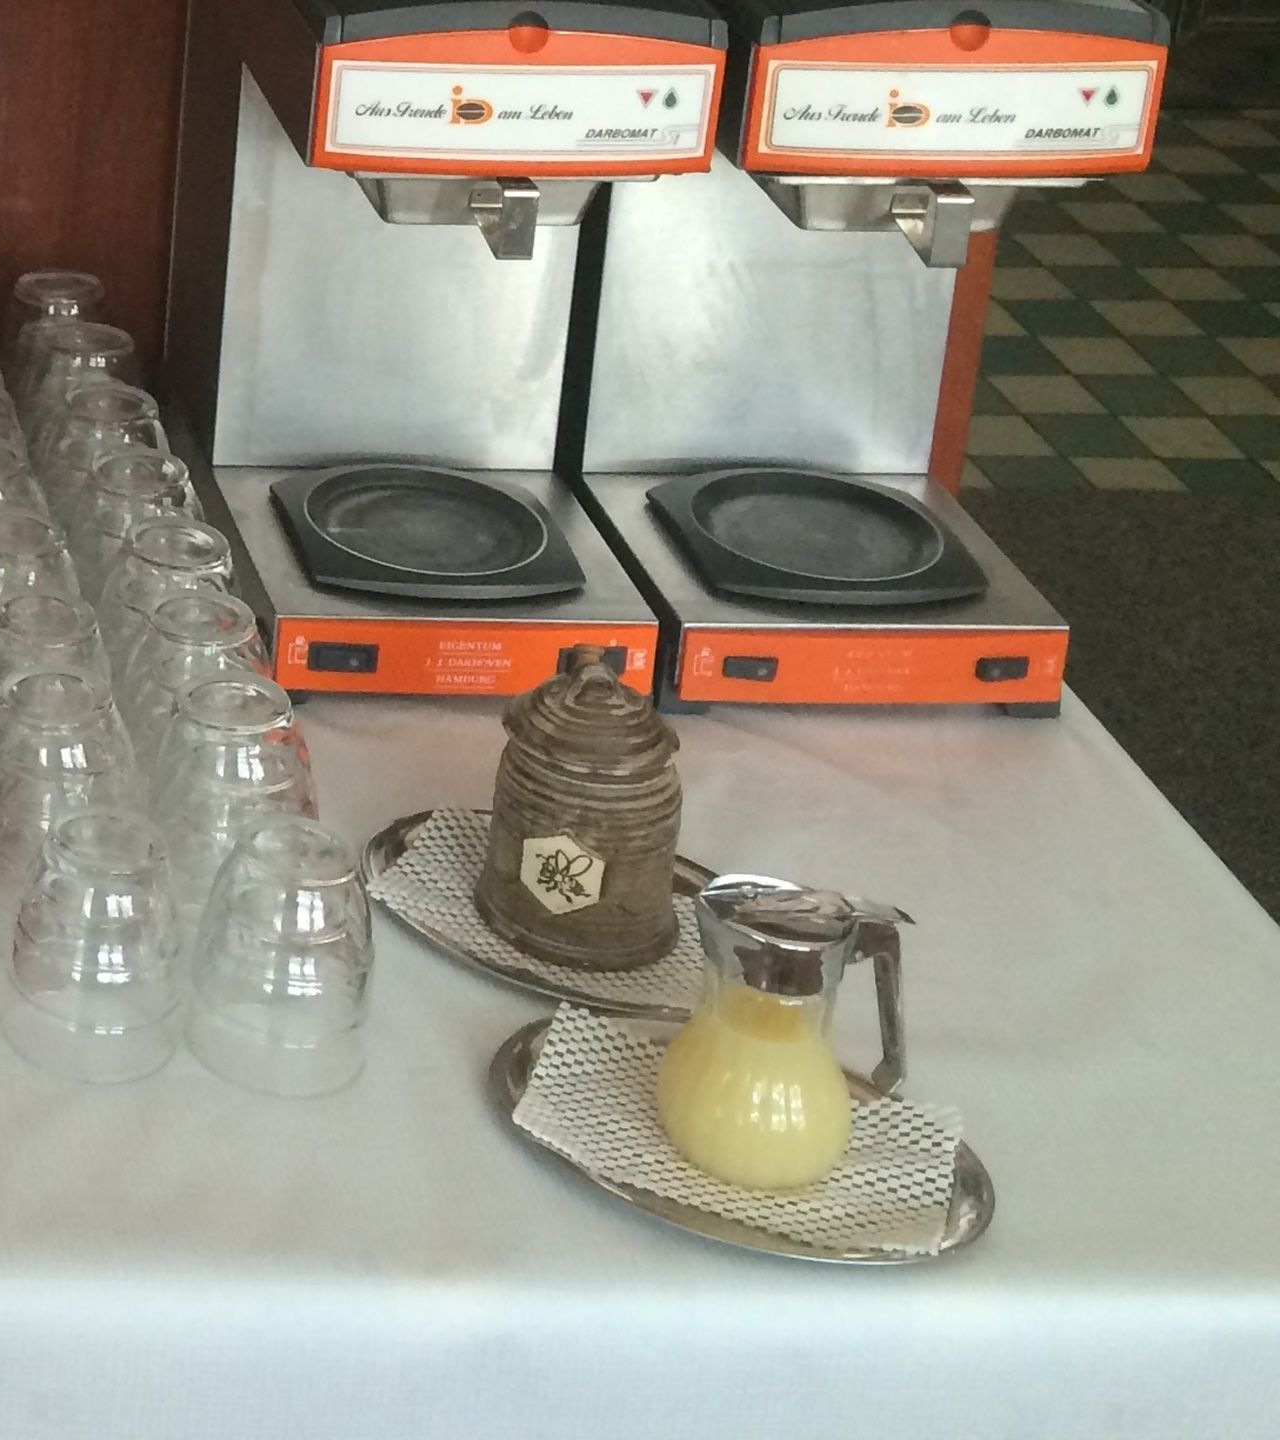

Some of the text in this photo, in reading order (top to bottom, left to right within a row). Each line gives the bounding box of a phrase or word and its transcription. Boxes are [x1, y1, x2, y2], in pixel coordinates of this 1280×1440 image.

[355, 101, 392, 118] Aus
[497, 109, 522, 120] am
[527, 103, 574, 121] Leben
[783, 104, 822, 121] Aus
[823, 103, 882, 122] Freude
[936, 113, 962, 124] am
[965, 106, 1017, 124] Leben
[585, 128, 658, 139] DARBOMAT
[1024, 127, 1101, 139] DARBOMAT
